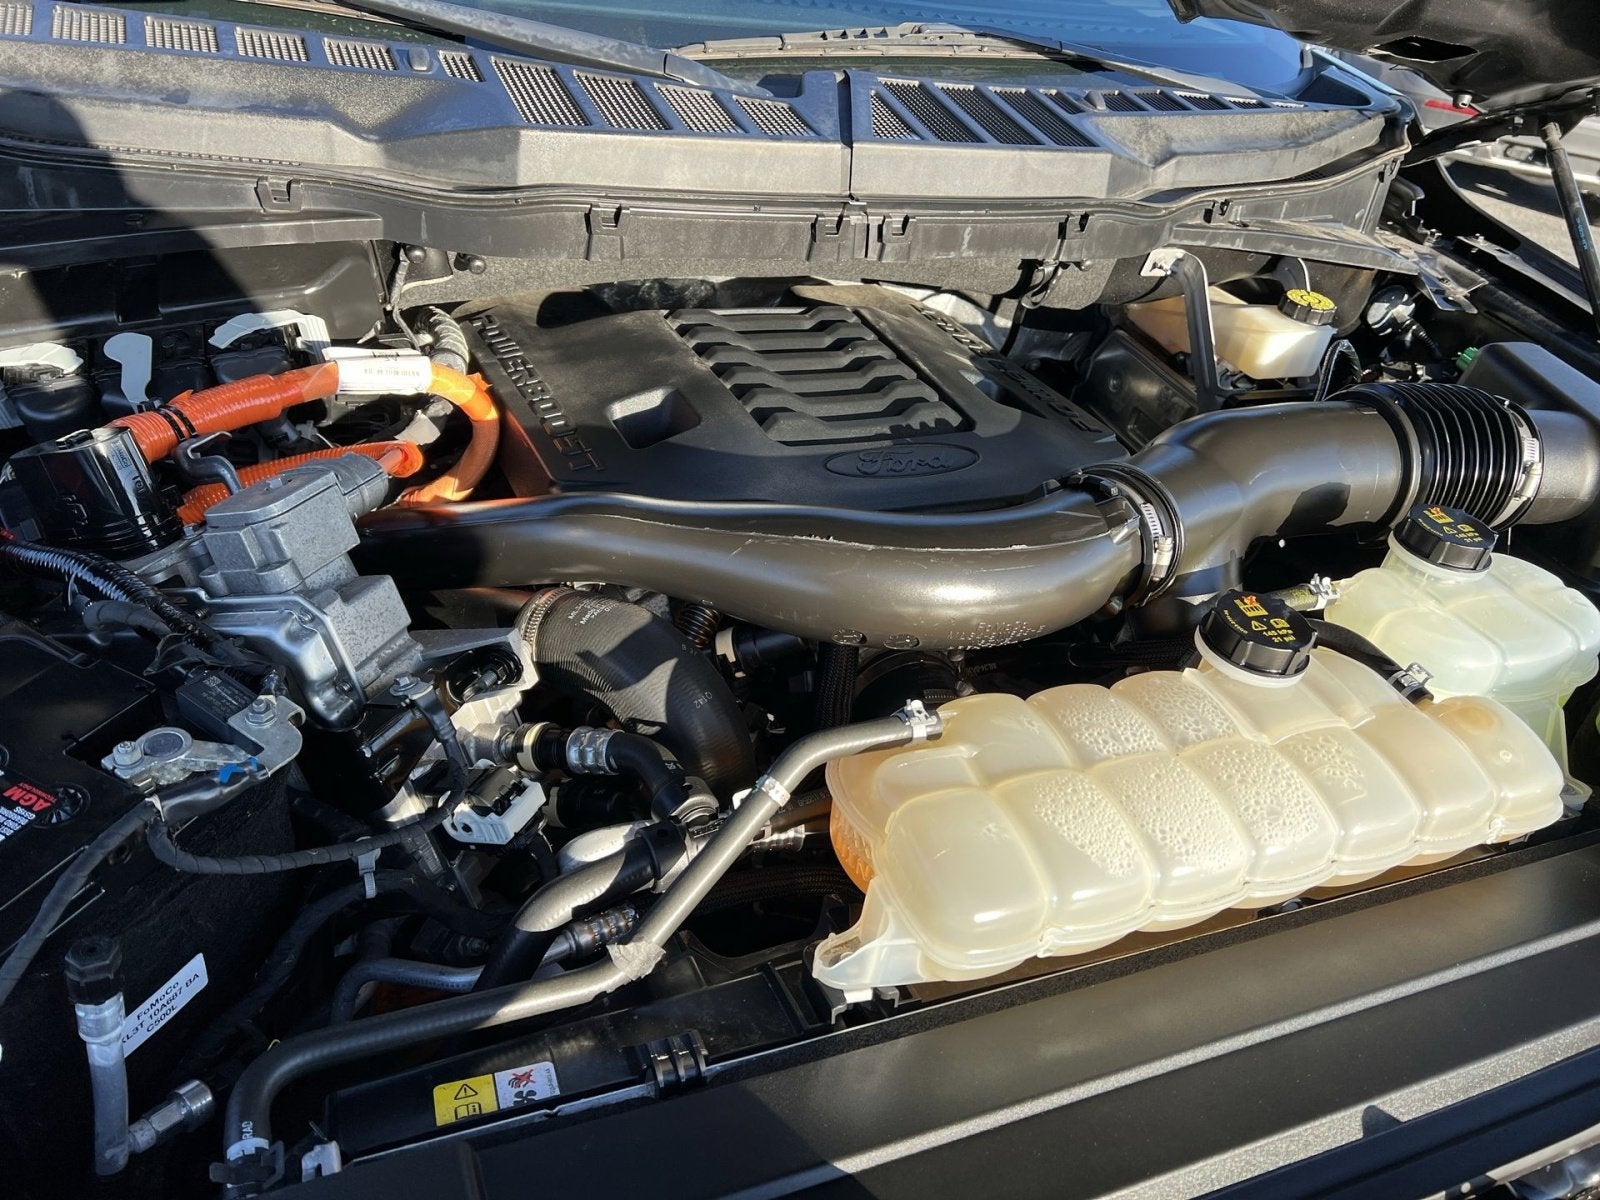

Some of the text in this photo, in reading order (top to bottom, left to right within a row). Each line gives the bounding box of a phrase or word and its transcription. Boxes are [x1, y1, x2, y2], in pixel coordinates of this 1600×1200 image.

[468, 314, 606, 472] POWERBOOST
[856, 449, 951, 475] Ford
[2, 786, 52, 811] AGM
[136, 981, 179, 1021] FoMoCo
[148, 987, 183, 1021] 10A687
[185, 973, 200, 988] BA
[241, 1120, 253, 1140] RAD
